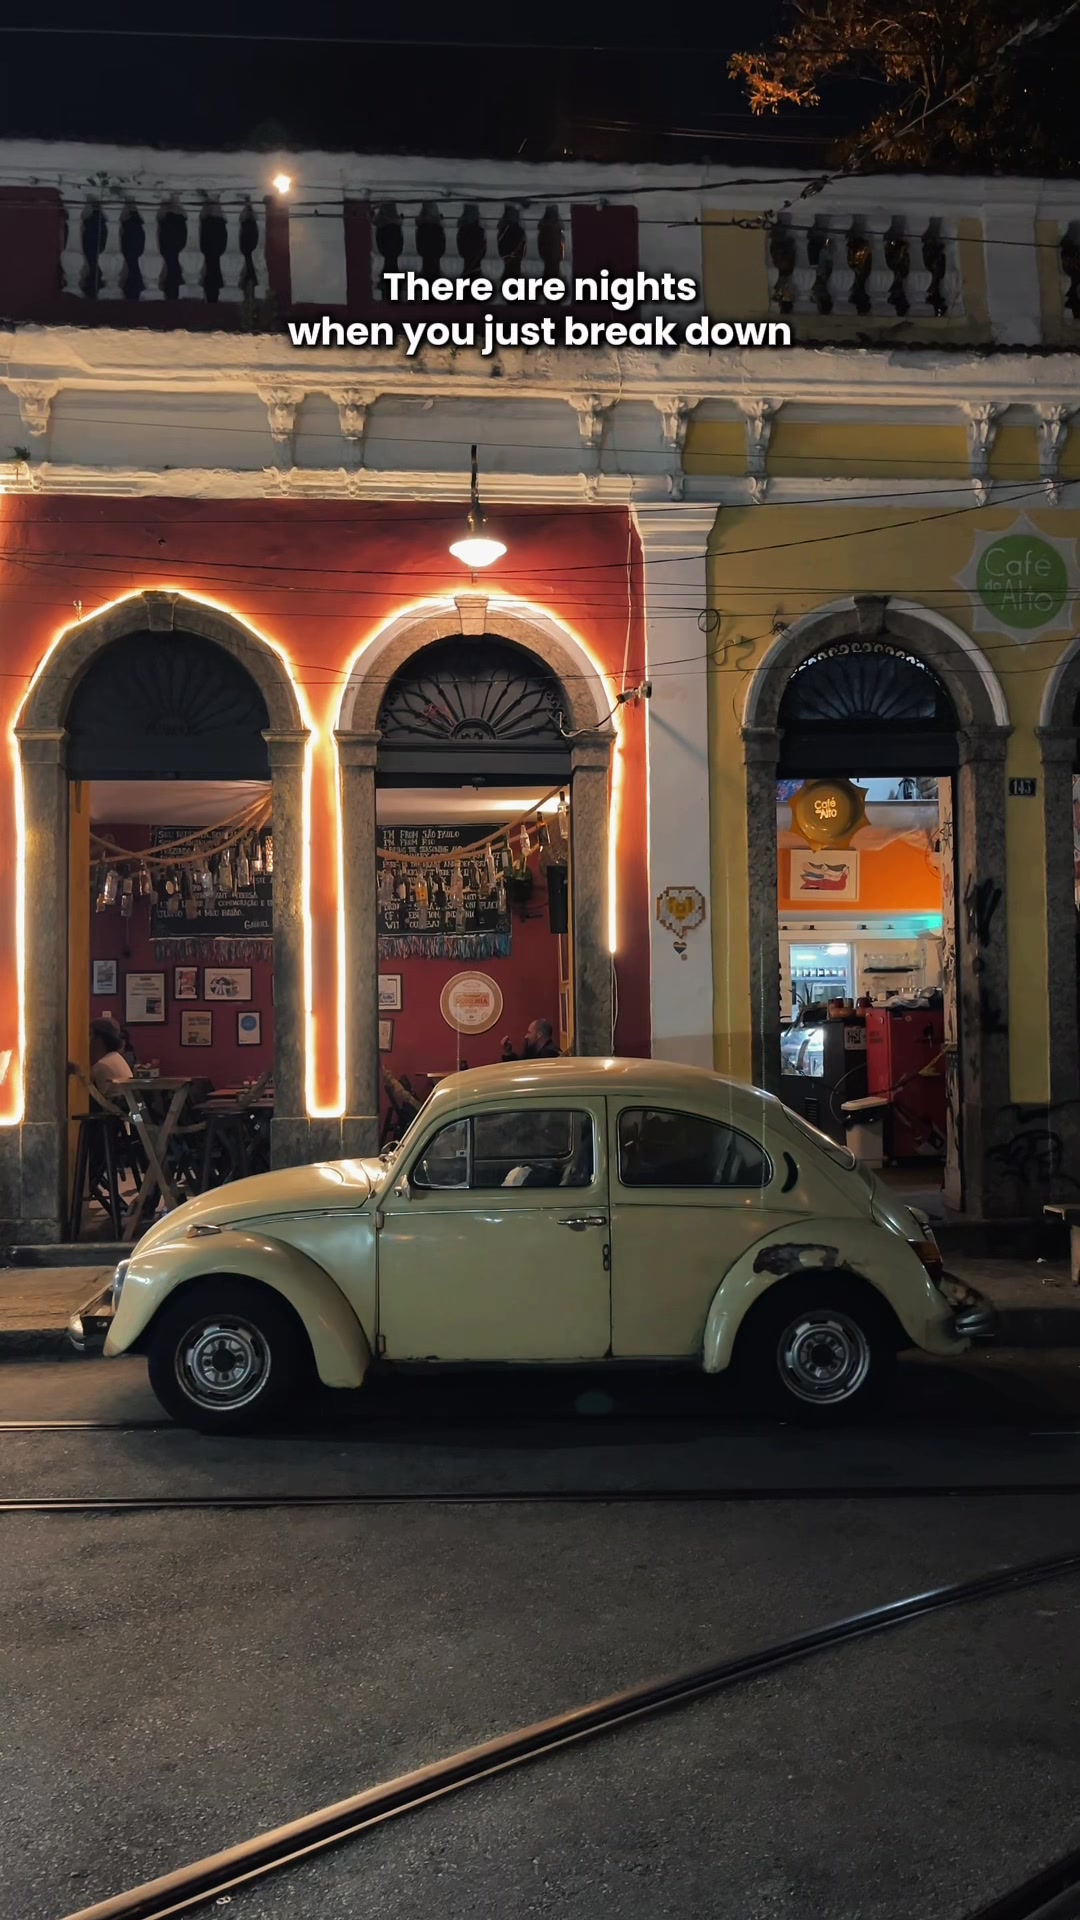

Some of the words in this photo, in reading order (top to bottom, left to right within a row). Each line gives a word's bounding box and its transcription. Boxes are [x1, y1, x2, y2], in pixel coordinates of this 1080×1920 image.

[985, 547, 1052, 577] Café
[985, 579, 1002, 591] do
[1000, 578, 1053, 612] Alto
[814, 796, 836, 810] Café
[819, 808, 838, 820] Alto
